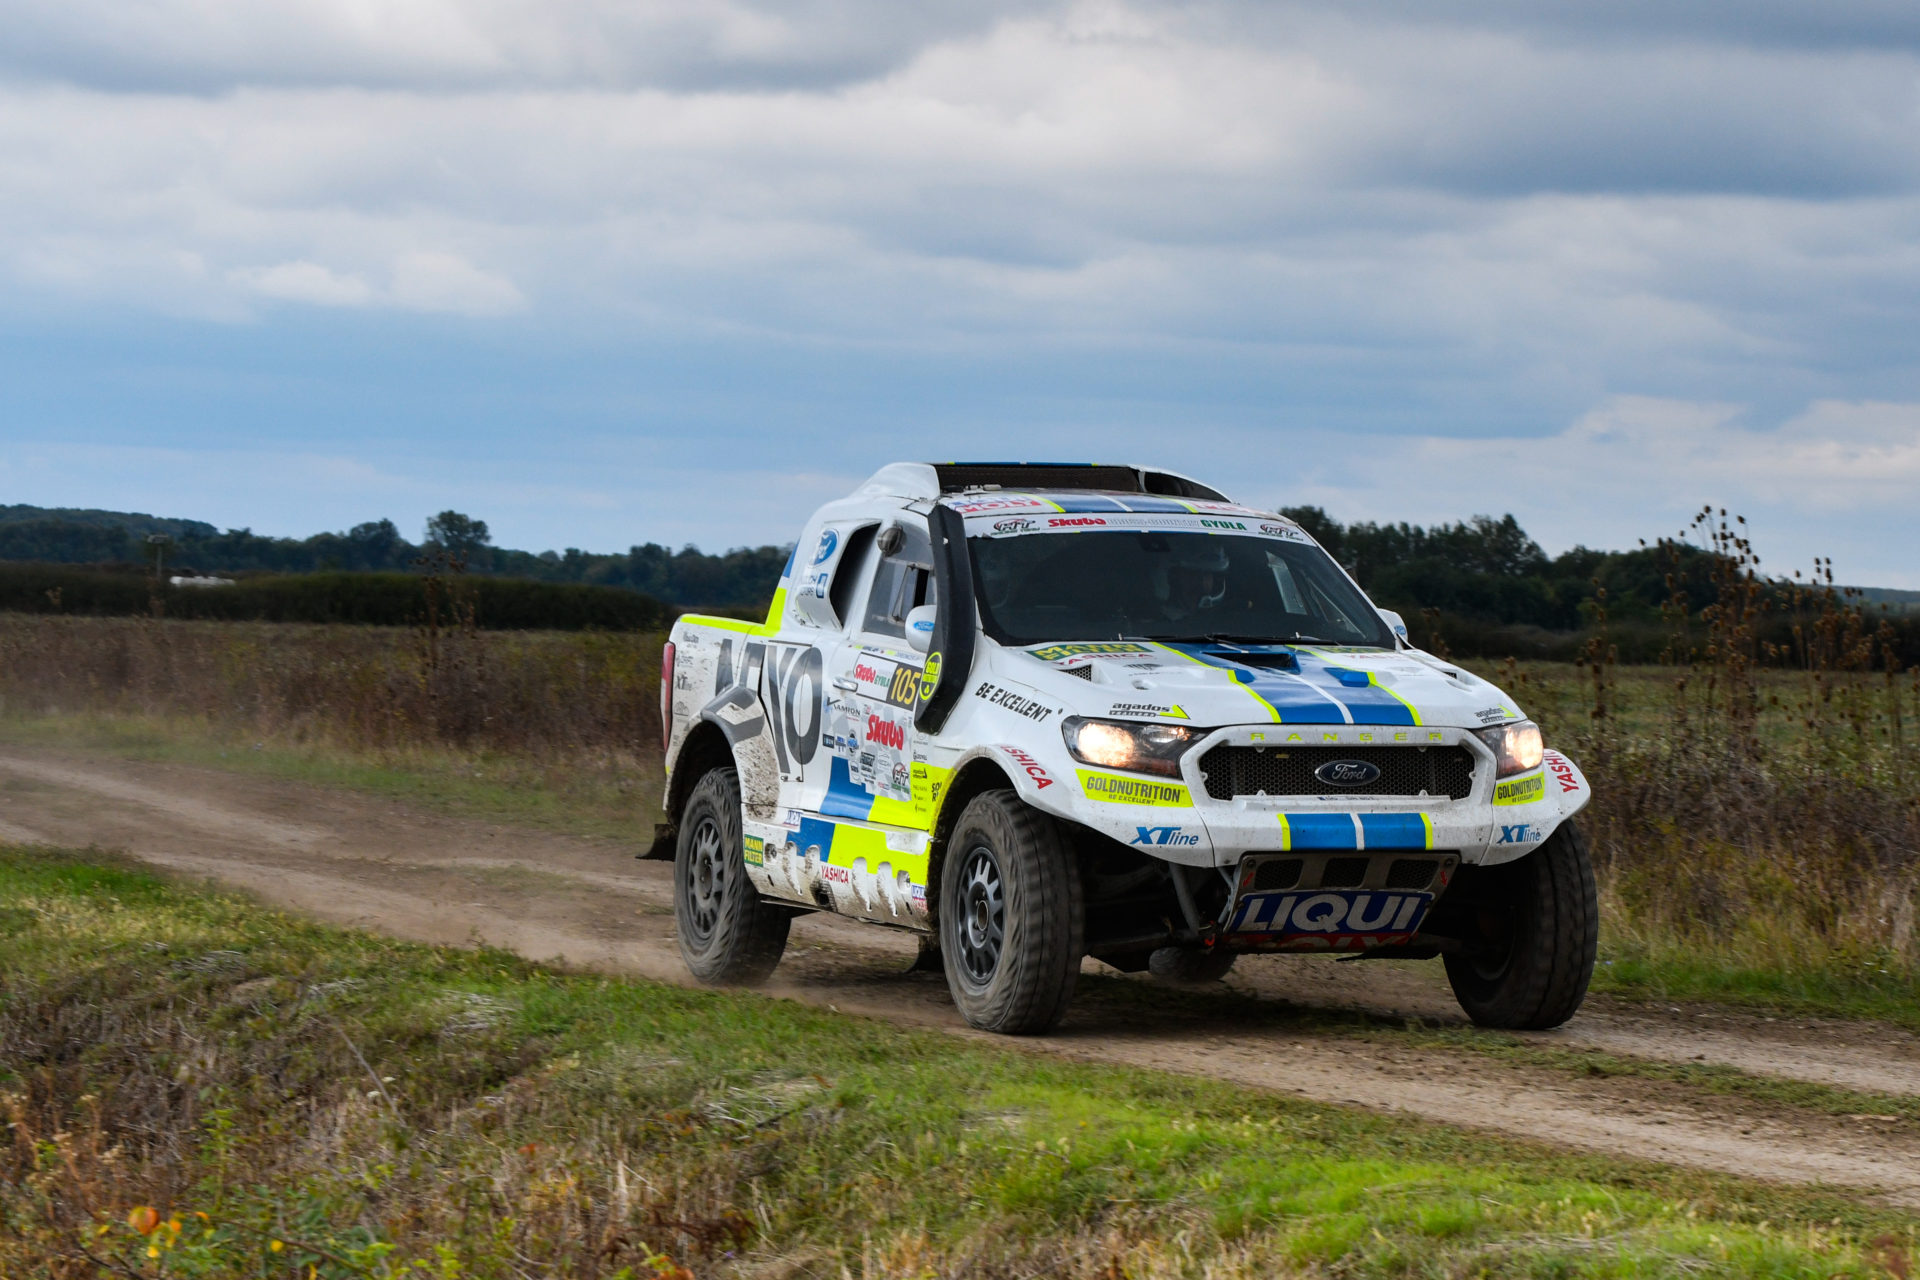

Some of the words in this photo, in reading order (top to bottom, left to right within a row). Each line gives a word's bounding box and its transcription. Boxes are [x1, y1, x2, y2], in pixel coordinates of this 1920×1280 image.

[1200, 519, 1247, 531] GYULA
[891, 667, 921, 705] 105
[975, 682, 995, 699] BE
[989, 688, 1052, 723] EXCELLENT
[1112, 702, 1170, 713] agados
[1250, 733, 1443, 742] RANGER
[1331, 763, 1367, 780] Ford
[1086, 776, 1181, 802] GOLDNUTRITION
[1497, 776, 1542, 800] GOLDNUTRITION
[745, 837, 763, 849] MANN
[1130, 826, 1199, 845] XTline
[1496, 824, 1541, 844] XTline
[745, 850, 763, 865] FILTER
[821, 865, 849, 884] YASHICA
[1237, 894, 1421, 933] LIQUI
